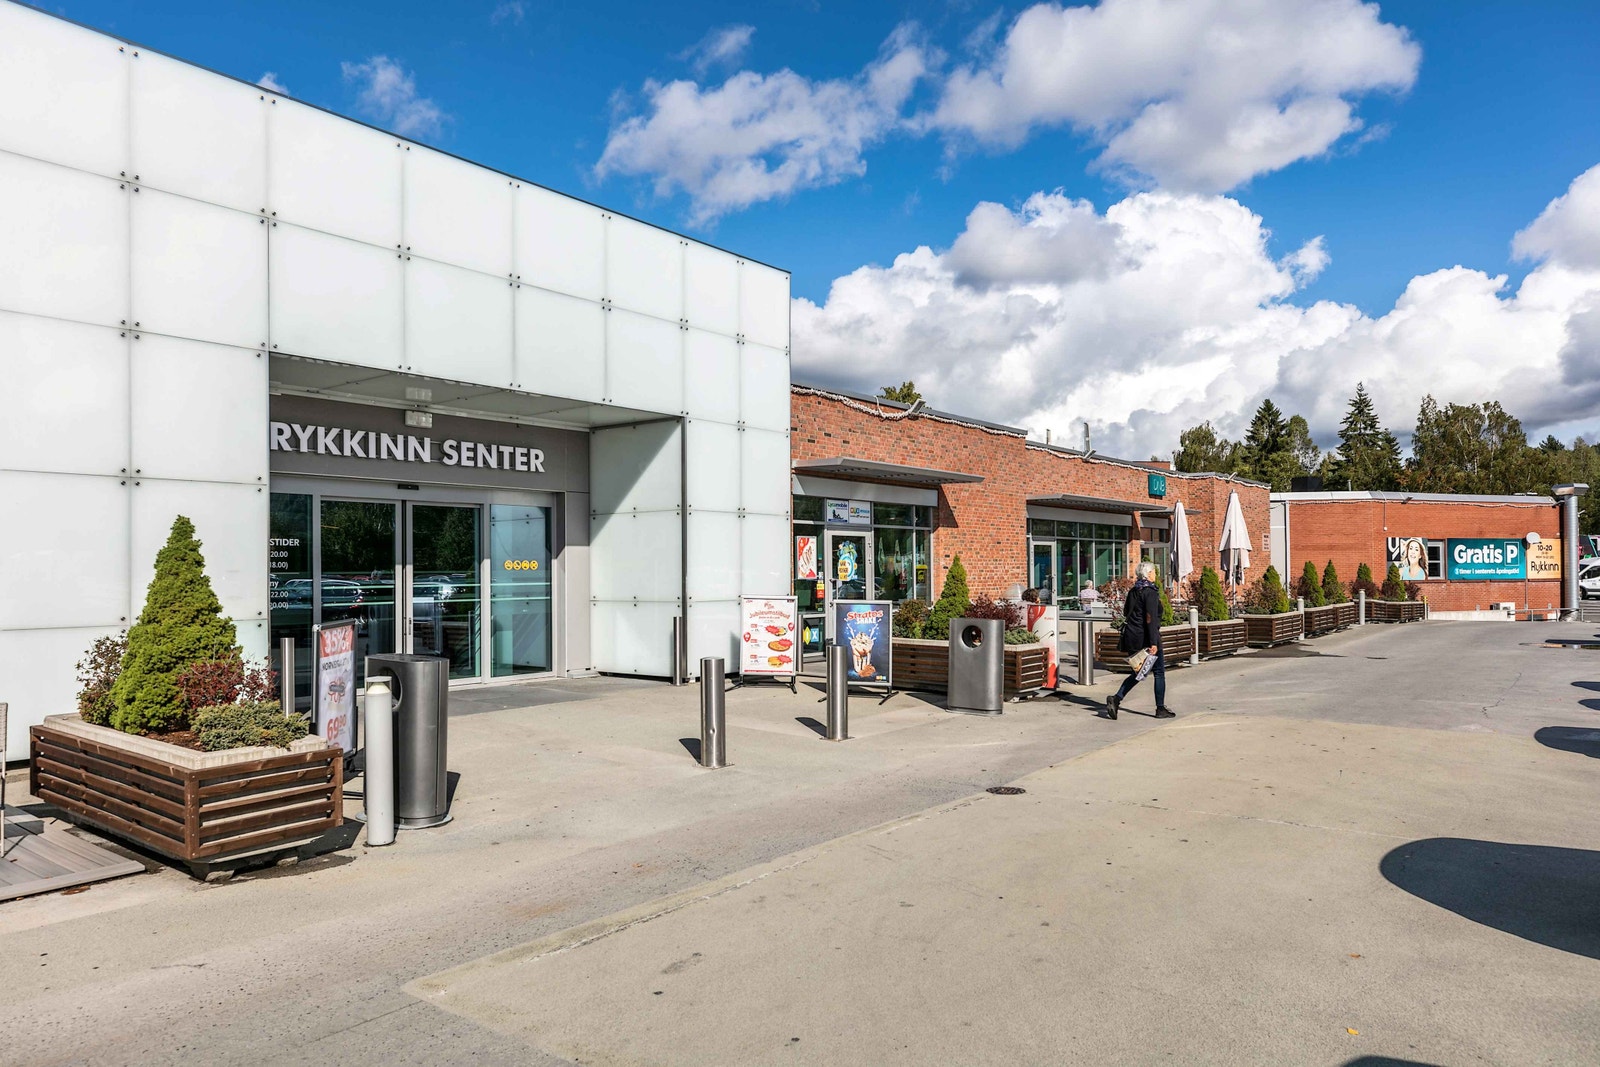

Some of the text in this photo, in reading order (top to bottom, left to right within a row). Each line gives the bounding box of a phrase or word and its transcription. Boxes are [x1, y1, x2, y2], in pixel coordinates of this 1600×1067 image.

[270, 422, 546, 473] RYKKINN SENTER
[270, 550, 289, 558] 20.00
[1454, 544, 1518, 564] Gratis P
[1496, 567, 1520, 575] åpningstid
[1530, 560, 1560, 573] Rykkinn
[846, 610, 884, 620] Stratos
